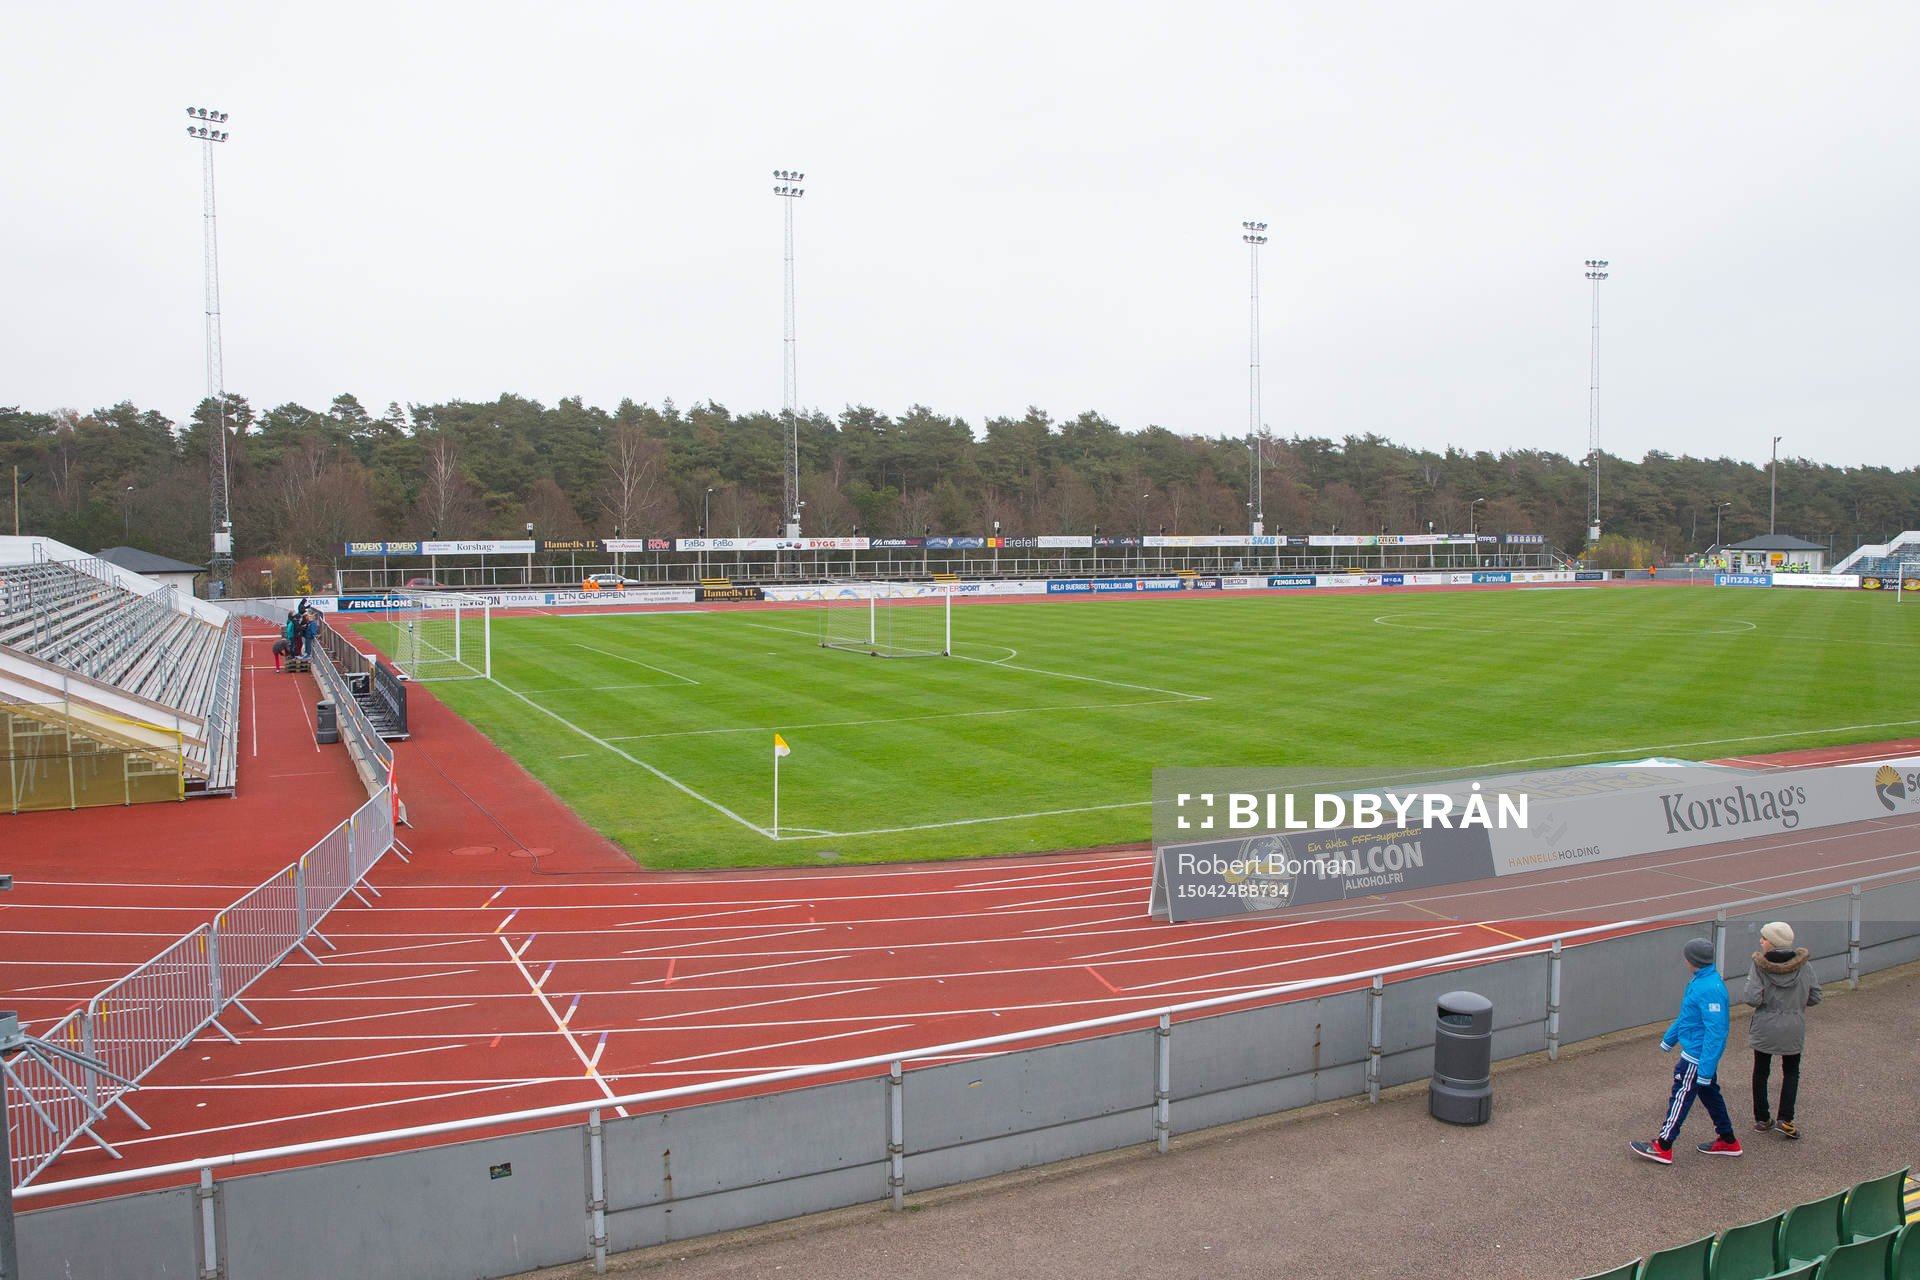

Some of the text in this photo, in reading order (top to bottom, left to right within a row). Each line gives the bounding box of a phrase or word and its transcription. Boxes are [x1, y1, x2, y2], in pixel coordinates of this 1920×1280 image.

[1004, 538, 1038, 548] Eirefelt
[1720, 575, 1766, 585] ginza.se
[558, 592, 577, 600] LTN
[578, 591, 626, 600] GRUPPEN
[354, 600, 413, 608] ENGELSONS
[1307, 843, 1321, 853] En
[1325, 839, 1348, 850] äkta
[1314, 841, 1424, 881] FALCON
[1345, 873, 1404, 890] ALKOHOLFRI
